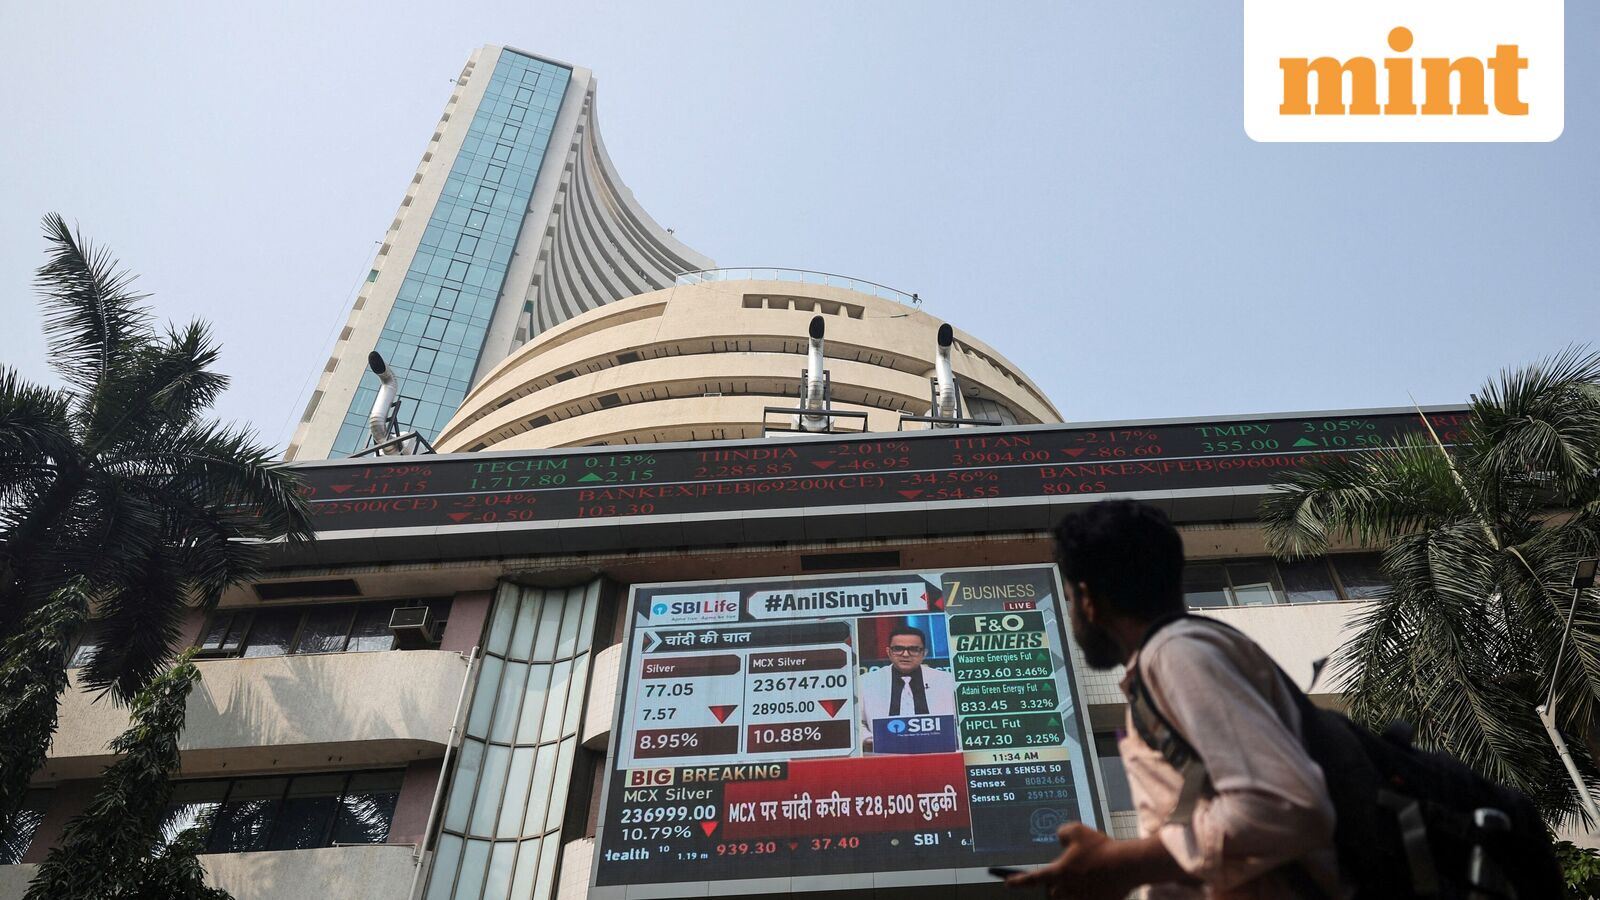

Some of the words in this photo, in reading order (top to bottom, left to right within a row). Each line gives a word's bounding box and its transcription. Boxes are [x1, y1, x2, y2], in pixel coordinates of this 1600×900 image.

[1195, 424, 1271, 438] TMPV
[1303, 419, 1376, 433] 3.05%
[951, 434, 1032, 450] TITAN
[1075, 430, 1158, 444] -2.17%
[1202, 438, 1279, 453] 355.00
[1320, 434, 1382, 448] 10.50
[697, 447, 798, 463] TIINDIA
[828, 441, 910, 456] -2.01%
[1089, 444, 1163, 458] -86.60
[352, 465, 433, 479] -1.29%
[474, 458, 568, 474] TECHM
[585, 454, 656, 469] 0.13%
[837, 457, 910, 471] -46.95
[605, 469, 654, 483] 2.15
[900, 470, 998, 486] -34.56%
[354, 480, 428, 494] -41.15
[1042, 480, 1106, 495] 80.65
[453, 494, 537, 508] -2.04%
[578, 503, 655, 518] 103.30
[926, 486, 999, 499] -54.55
[473, 509, 535, 523] -0.50
[765, 588, 908, 613] #AnilSinghvi
[962, 584, 1036, 601] BUSINESS
[670, 601, 701, 615] SBI
[703, 599, 737, 613] Life
[1009, 601, 1032, 610] LIVE
[974, 614, 1025, 633] F&O
[665, 630, 697, 646] चांदी
[699, 630, 720, 644] की
[722, 632, 752, 643] चाल
[956, 632, 1043, 652] GAINERS
[753, 657, 774, 668] MCX
[777, 657, 806, 667] Silver
[957, 654, 985, 664] Waaree
[987, 653, 1019, 664] Energies
[1020, 651, 1033, 660] Fut
[646, 664, 676, 674] Silver
[957, 667, 1012, 680] 2739.60
[1015, 666, 1048, 677] 3.46%
[645, 682, 694, 698] 77.05
[753, 674, 848, 693] 236747.00
[961, 686, 980, 695] Adani
[981, 684, 1001, 694] Green
[1002, 683, 1025, 695] Energy
[1026, 682, 1038, 692] Fut
[752, 700, 815, 716] 28905.00
[961, 700, 1008, 712] 833.45
[1020, 698, 1054, 709] 3.32%
[643, 707, 677, 721] 7.57
[907, 717, 941, 734] SBI
[966, 719, 998, 731] HPCL
[1002, 718, 1022, 729] Fut
[640, 732, 698, 750] 8.95%
[754, 726, 821, 744] 10.88%
[965, 734, 1013, 747] 447.30
[1025, 733, 1060, 744] 3.25%
[992, 752, 1021, 762] 11:34
[1024, 751, 1039, 761] AM
[630, 768, 672, 786] BIG
[682, 763, 782, 783] BREAKING
[970, 767, 1003, 777] SENSEX
[1005, 767, 1012, 775] &
[1014, 765, 1047, 774] SENSEX
[1049, 764, 1062, 773] 50
[970, 779, 1006, 789] Sensex
[624, 789, 659, 804] MCX
[665, 787, 713, 801] Silver
[971, 794, 1000, 803] Sensex
[1003, 792, 1016, 801] 50
[621, 804, 716, 824] 236999.00
[729, 802, 756, 823] MCX
[761, 800, 778, 820] पर
[781, 792, 813, 821] चांदी
[815, 790, 852, 818] करीब
[855, 793, 914, 819] ₹28,500
[622, 825, 692, 841] 10.79%
[659, 845, 670, 853] 10
[678, 852, 697, 860] 1.19
[717, 841, 776, 856] 939.30
[811, 836, 860, 850] 37.40
[914, 833, 940, 847] SBI
